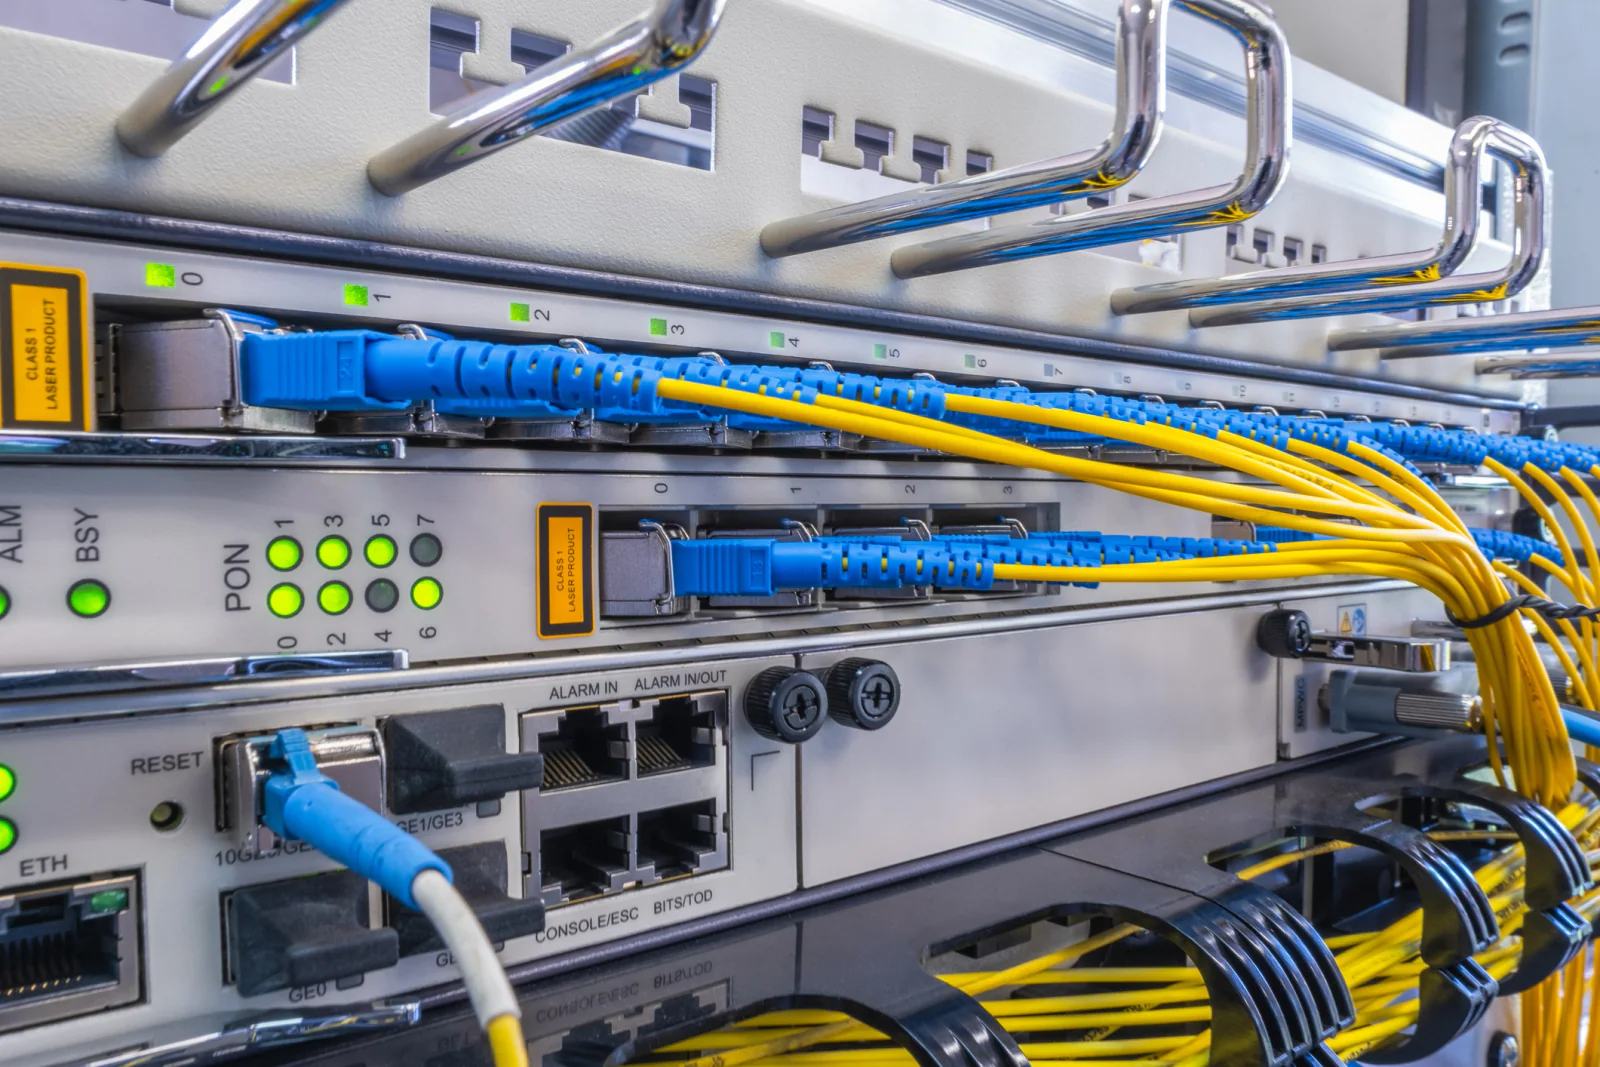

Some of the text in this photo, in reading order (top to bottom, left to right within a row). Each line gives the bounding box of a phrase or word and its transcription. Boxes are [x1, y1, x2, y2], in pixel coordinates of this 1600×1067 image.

[181, 271, 203, 287] 0
[373, 292, 391, 302] 1
[534, 308, 550, 322] 2
[671, 324, 685, 336] 3
[788, 337, 800, 348] 4
[25, 337, 38, 381] CLASS
[42, 298, 58, 410] LASER PRODUCT
[889, 348, 900, 358] 5
[978, 358, 987, 368] 6
[1054, 367, 1064, 376] 7
[1123, 375, 1132, 384] 8
[1184, 382, 1192, 391] 9
[1239, 385, 1246, 398] 10
[654, 482, 669, 494] 0
[789, 486, 802, 495] 1
[904, 484, 916, 494] 2
[1002, 485, 1013, 494] 3
[273, 518, 294, 528] 1
[324, 514, 343, 527] 3
[371, 513, 390, 527] 5
[416, 513, 435, 527] 7
[0, 504, 23, 564] ALM
[74, 508, 99, 562] BSY
[556, 557, 565, 592] CLASS
[567, 527, 576, 613] LASER PRODUCT
[224, 543, 251, 612] PON
[326, 631, 346, 646] 2
[374, 628, 392, 643] 4
[418, 626, 437, 640] 6
[277, 635, 297, 649] 0
[634, 670, 728, 691] ALARM IN/OUT
[549, 681, 618, 700] ALARM IN
[130, 751, 204, 775] RESET
[20, 854, 68, 877] ETH
[653, 889, 713, 915] BITS/TOD
[535, 906, 640, 944] CONSOLE/ESC
[288, 981, 327, 1003] GE0
